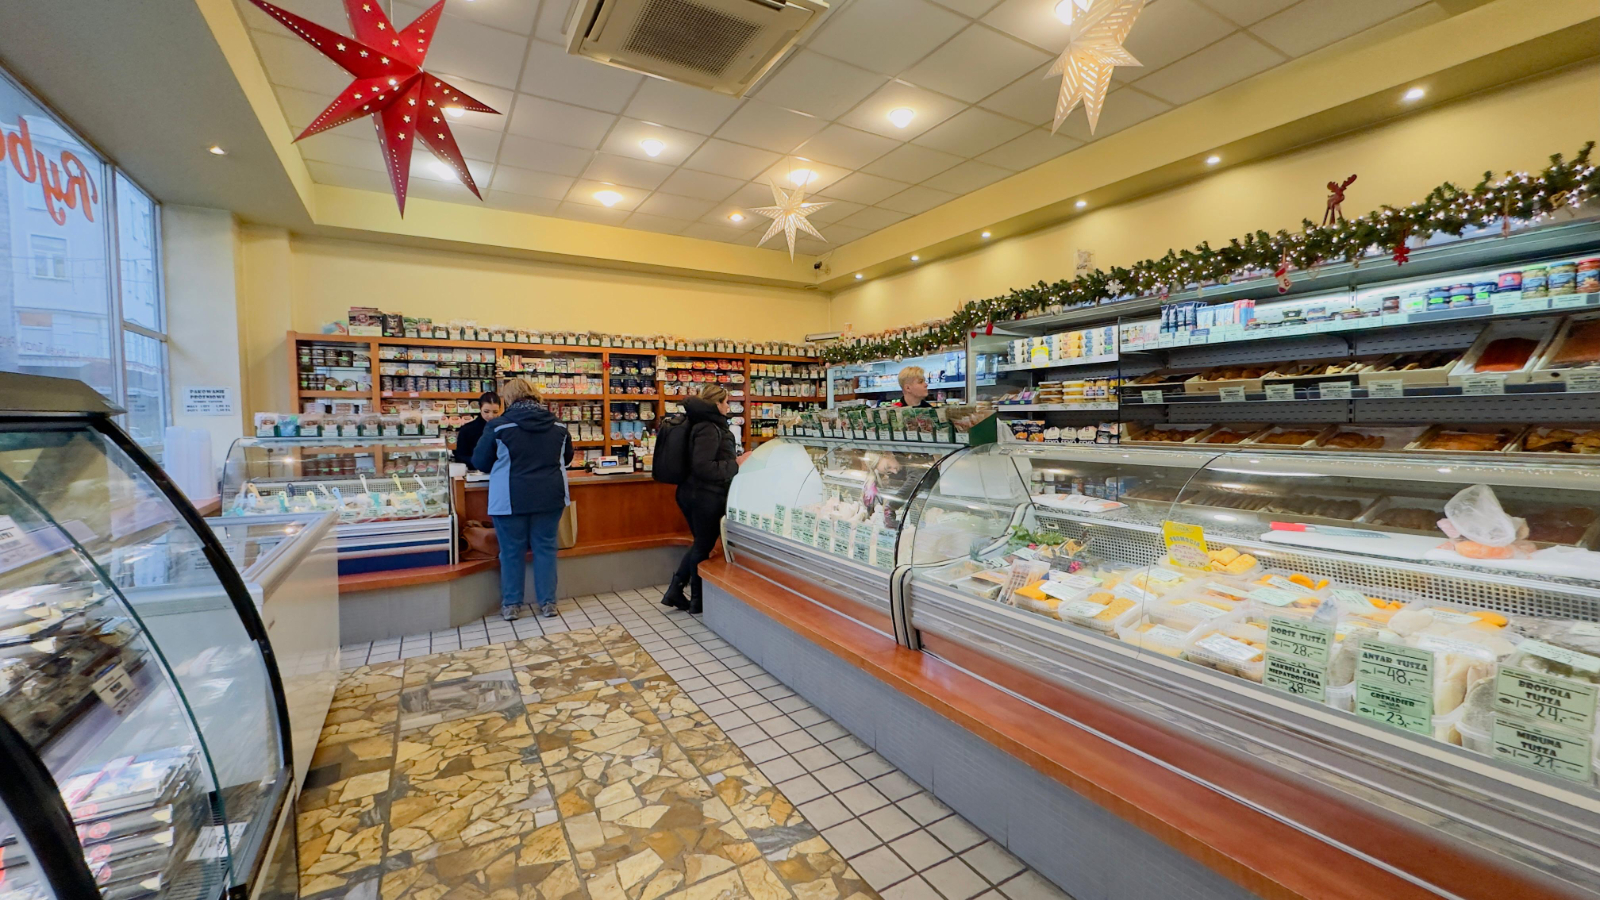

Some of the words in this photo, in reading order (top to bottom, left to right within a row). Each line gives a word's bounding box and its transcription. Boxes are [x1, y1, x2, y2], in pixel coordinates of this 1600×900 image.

[1270, 626, 1296, 638] DORSZ
[1299, 633, 1327, 645] TUSZA
[1270, 662, 1300, 674] MAKRELA
[1362, 652, 1393, 664] ANTAR
[1396, 659, 1428, 672] TUSZA
[1268, 667, 1321, 687] NIEPATROSZONA
[1518, 680, 1572, 700] BROTOLA
[1525, 691, 1562, 707] TUSZA
[1370, 692, 1416, 707] GRENADIER
[1516, 731, 1563, 749] MIRUNA
[1520, 741, 1557, 757] TUSZA
